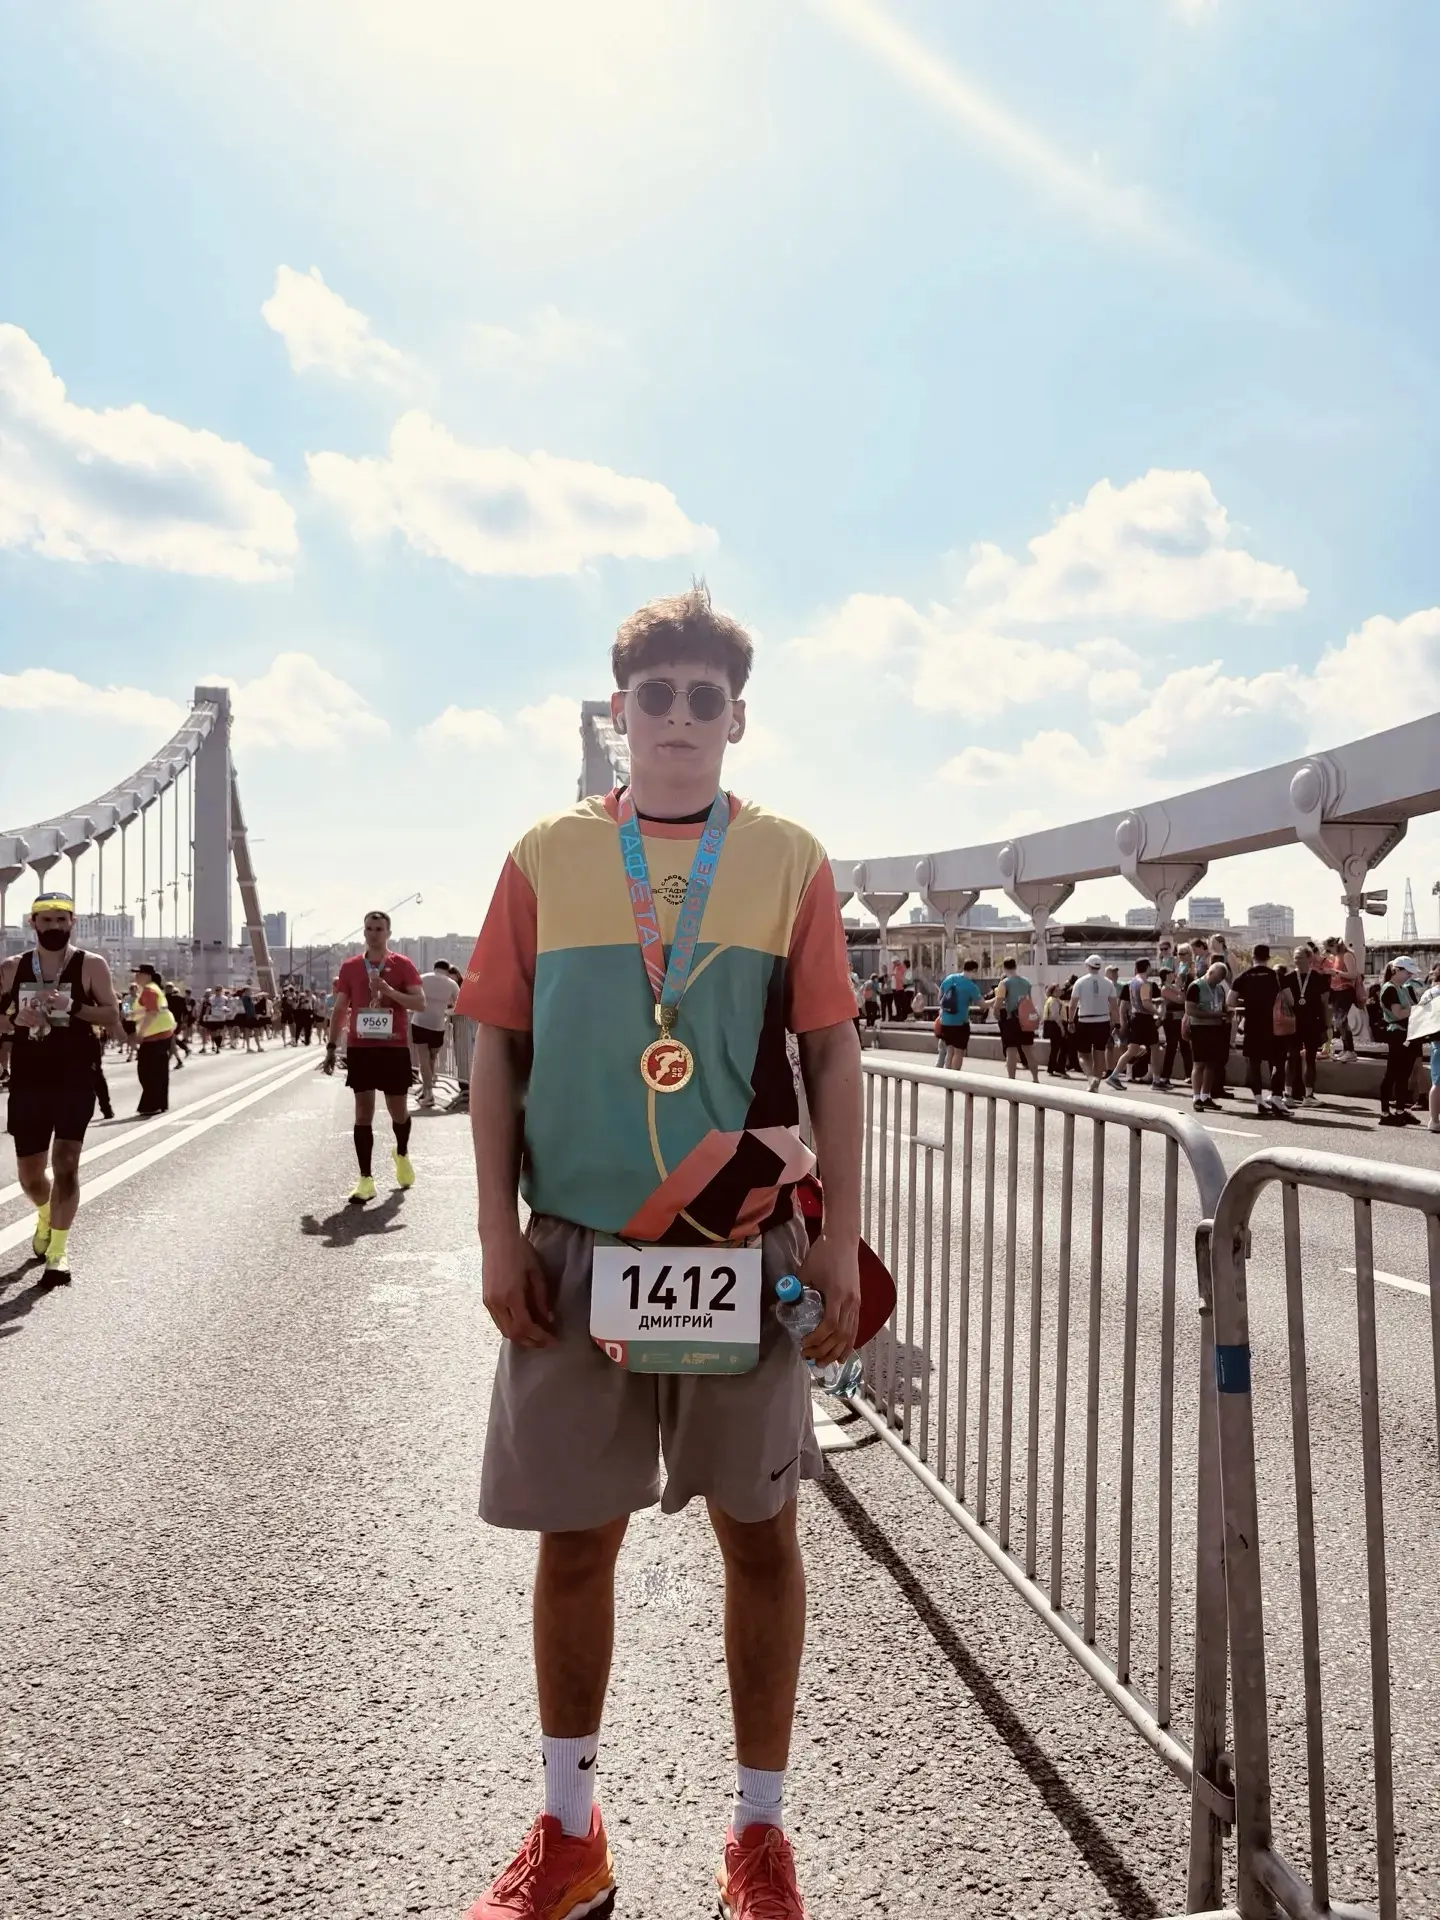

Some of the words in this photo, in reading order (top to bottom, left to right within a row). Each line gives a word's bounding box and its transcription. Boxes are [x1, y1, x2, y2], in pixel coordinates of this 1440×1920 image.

[618, 797, 660, 949] СТАФЕТА
[651, 887, 688, 895] ЭСТАФЕ
[362, 1017, 388, 1027] 9569
[622, 1265, 737, 1311] 1412
[638, 1313, 713, 1330] ДМИТРИЙ
